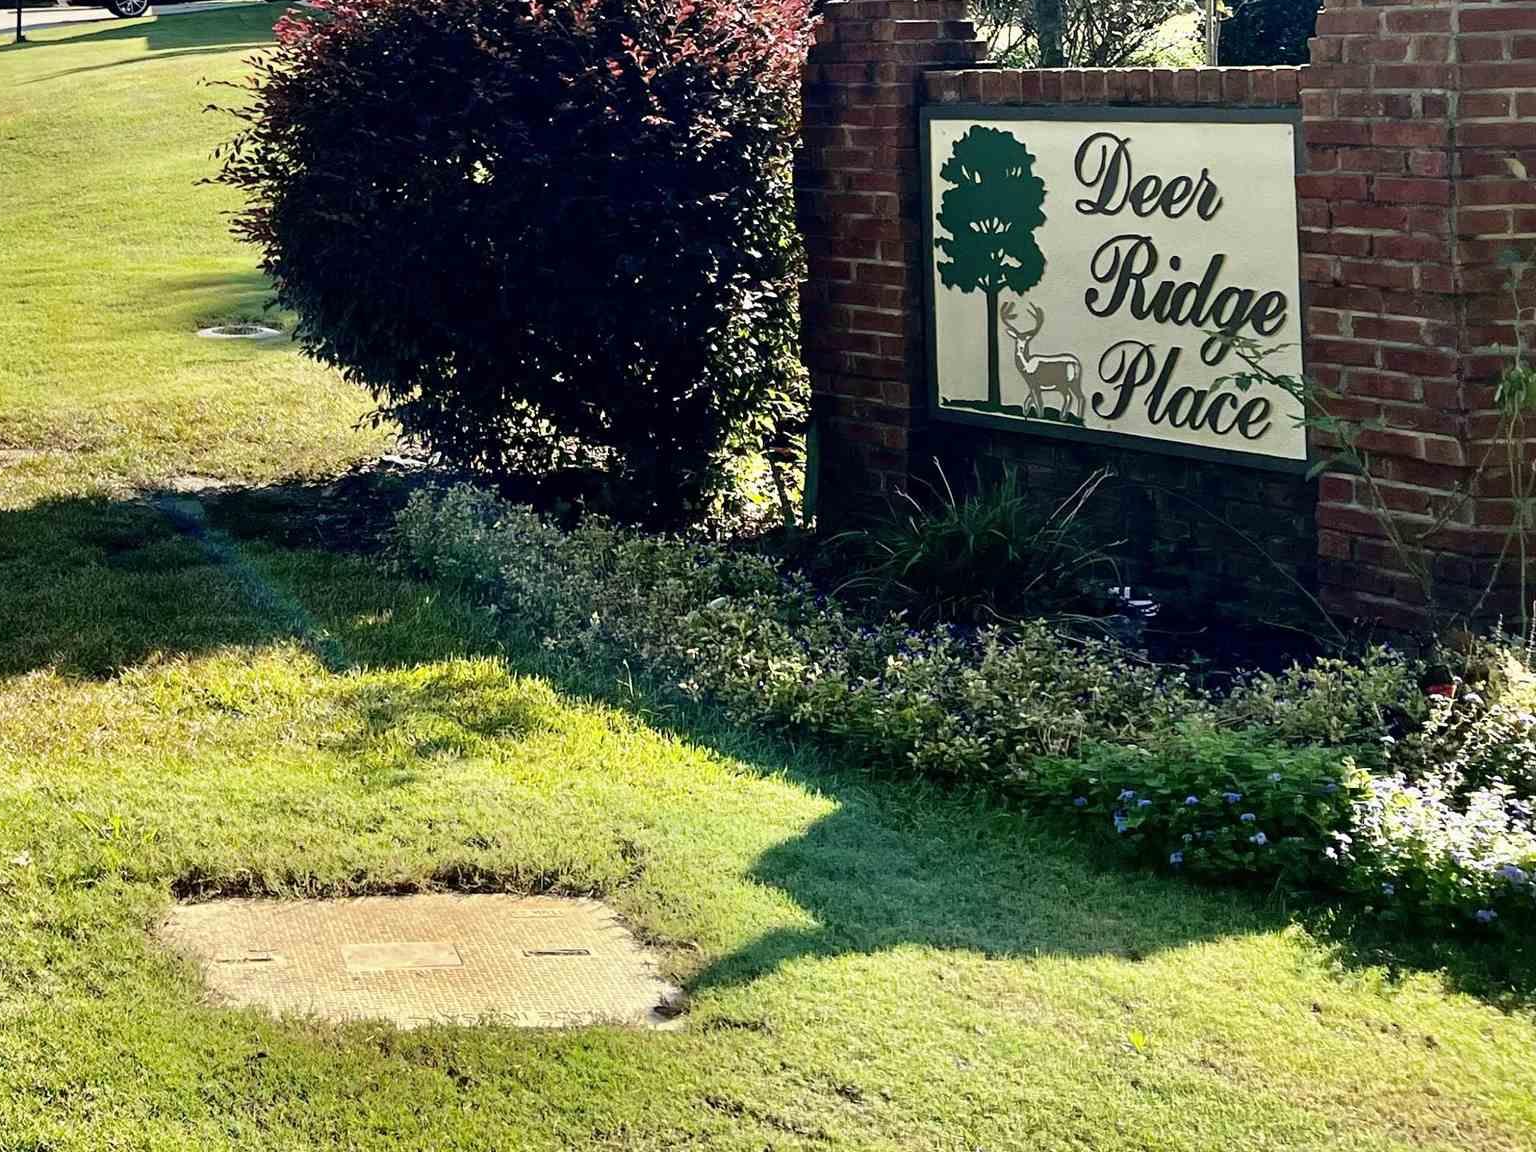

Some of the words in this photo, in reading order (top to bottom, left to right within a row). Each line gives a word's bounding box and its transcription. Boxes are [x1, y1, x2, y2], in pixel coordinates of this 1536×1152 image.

[1074, 132, 1223, 221] Deer
[1085, 234, 1287, 366] Ridge
[1091, 340, 1272, 440] Place
